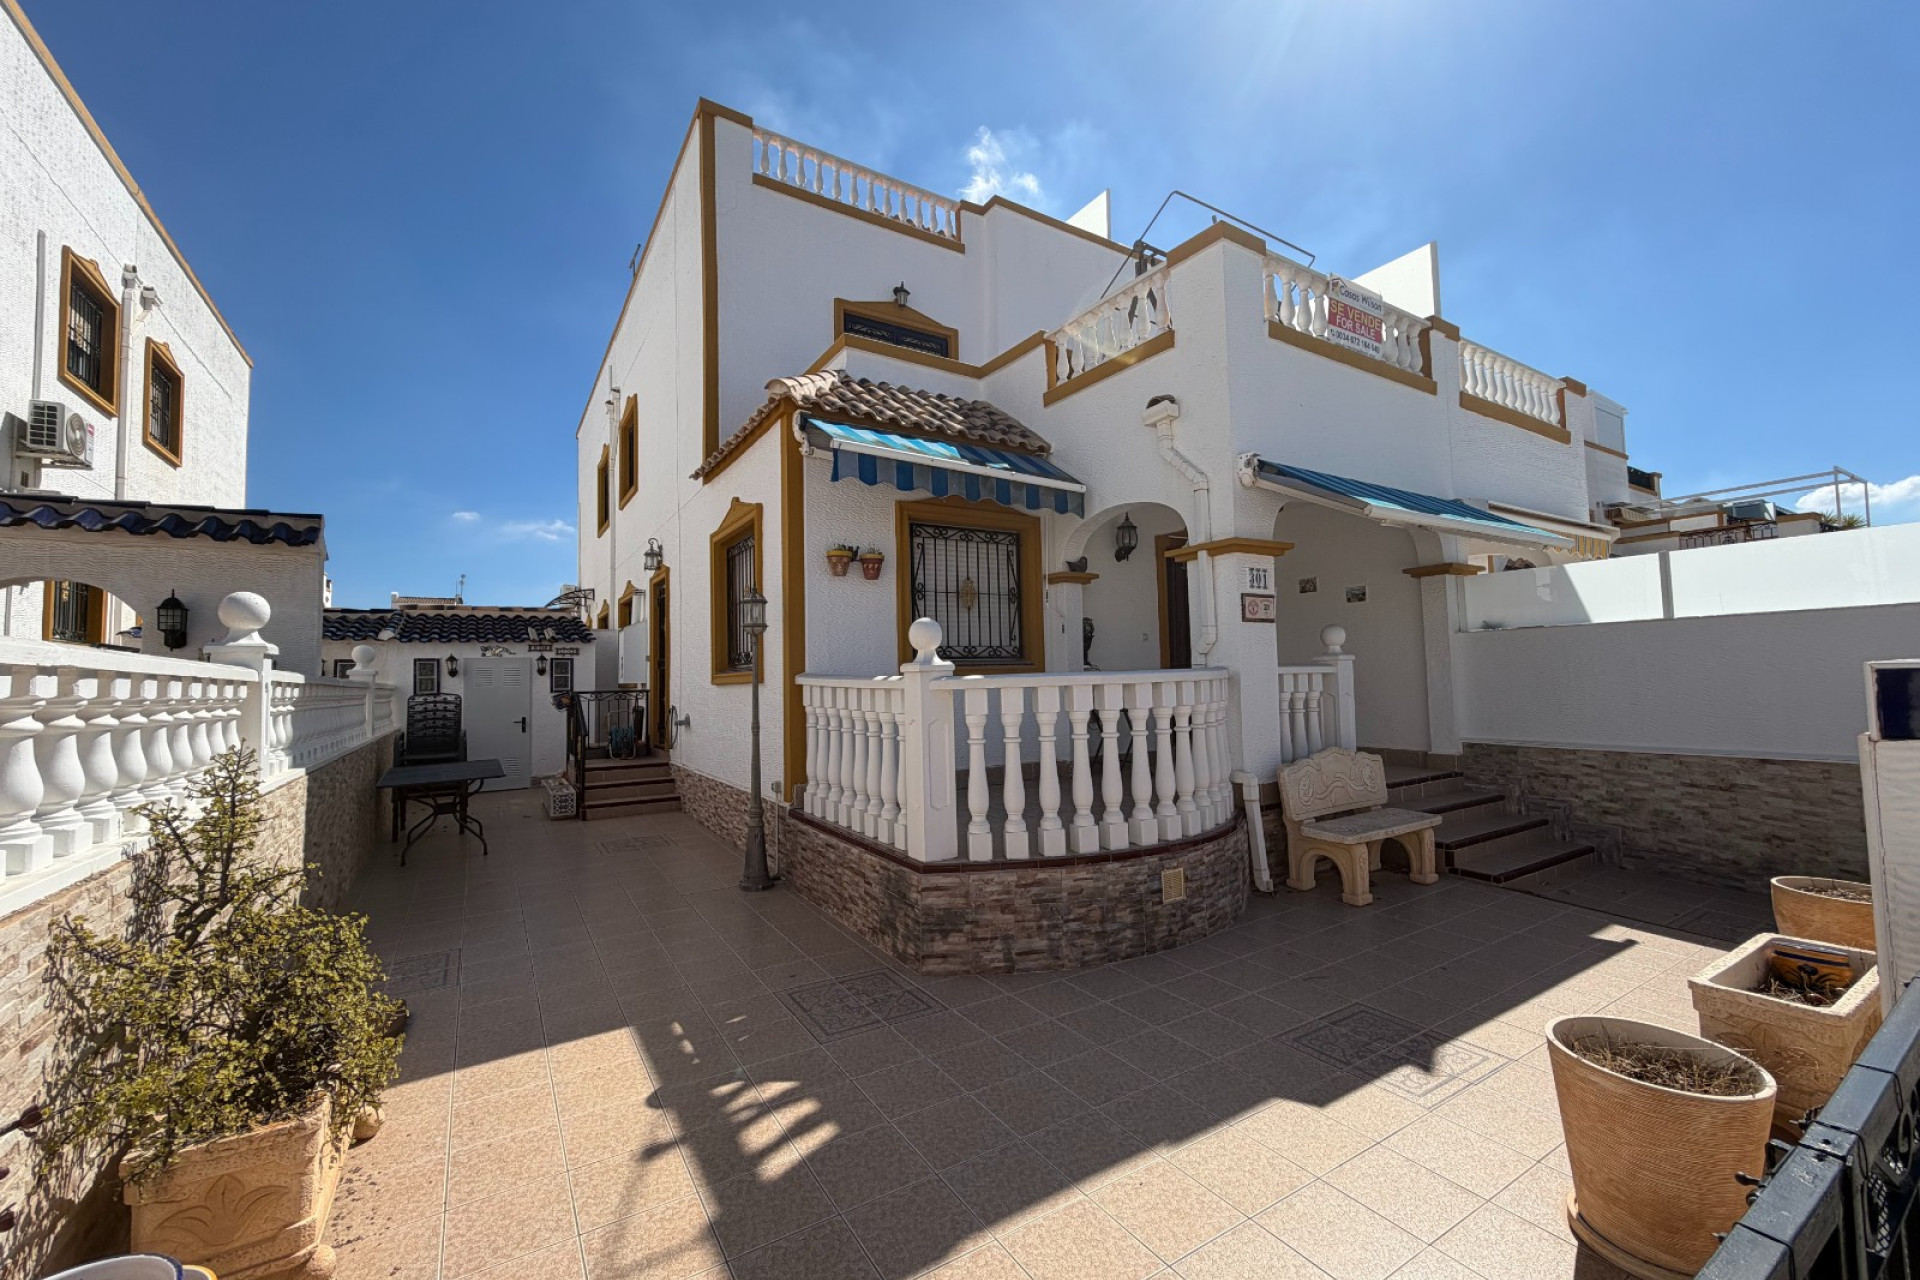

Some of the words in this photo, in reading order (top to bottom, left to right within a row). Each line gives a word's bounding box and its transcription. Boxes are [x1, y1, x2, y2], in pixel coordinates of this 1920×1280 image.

[1340, 285, 1359, 302] Casas
[1361, 294, 1382, 311] Wilson
[1331, 299, 1345, 316] SE
[1347, 306, 1382, 331] VENDE
[1336, 315, 1353, 332] FOR
[1355, 322, 1376, 340] SALE
[1249, 568, 1268, 590] 301
